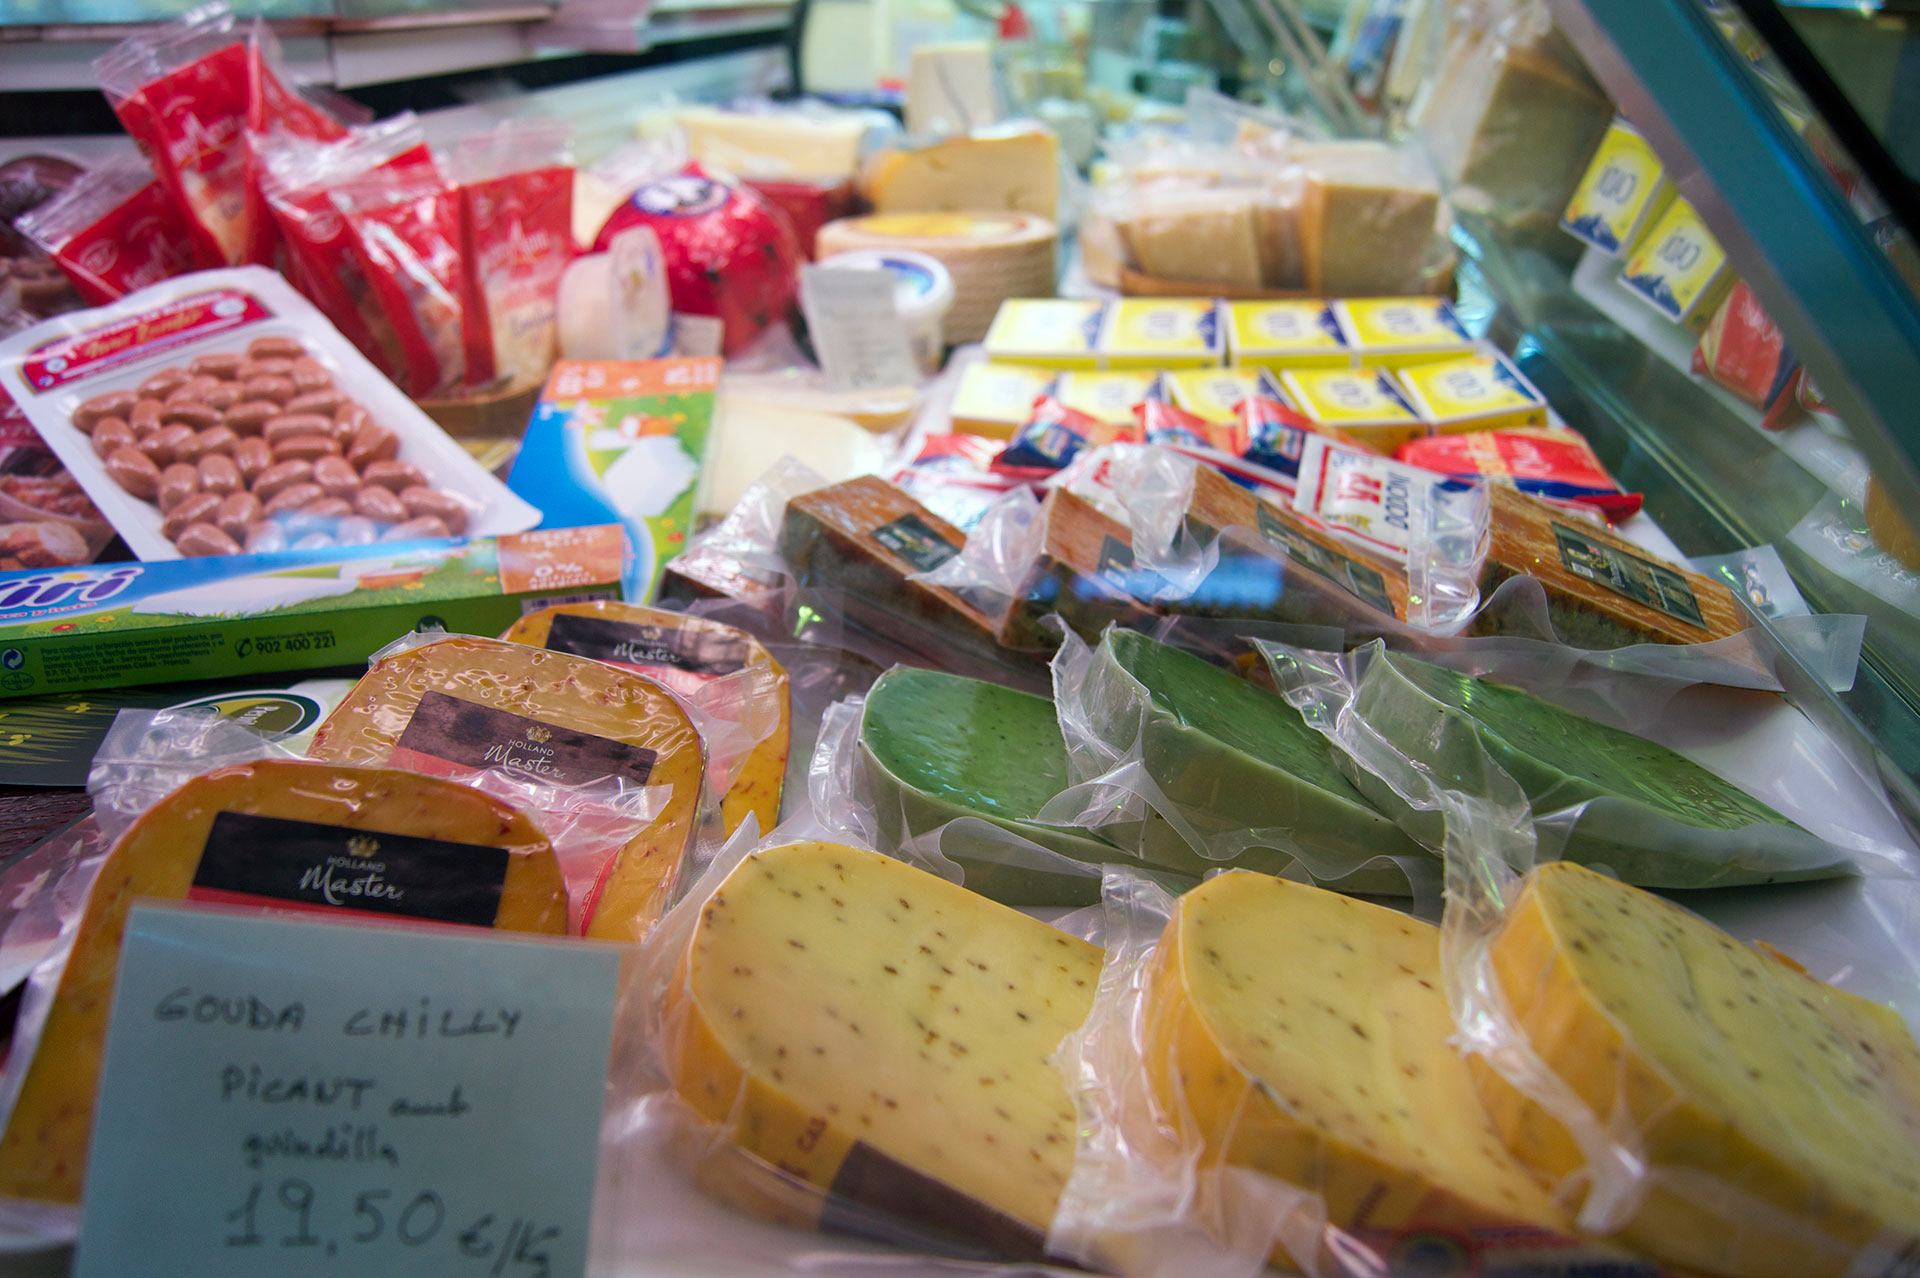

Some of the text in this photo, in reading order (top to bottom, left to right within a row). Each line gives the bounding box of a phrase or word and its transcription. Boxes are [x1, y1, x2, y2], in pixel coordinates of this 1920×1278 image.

[0, 567, 146, 610] iri
[255, 640, 281, 656] 902
[285, 637, 310, 652] 400
[313, 635, 336, 650] 221
[613, 643, 680, 665] Master
[484, 744, 567, 779] Master
[508, 739, 555, 757] HOLLAND
[326, 856, 386, 873] HOLLAND
[299, 864, 405, 905] Master
[154, 986, 306, 1032] GOUDA
